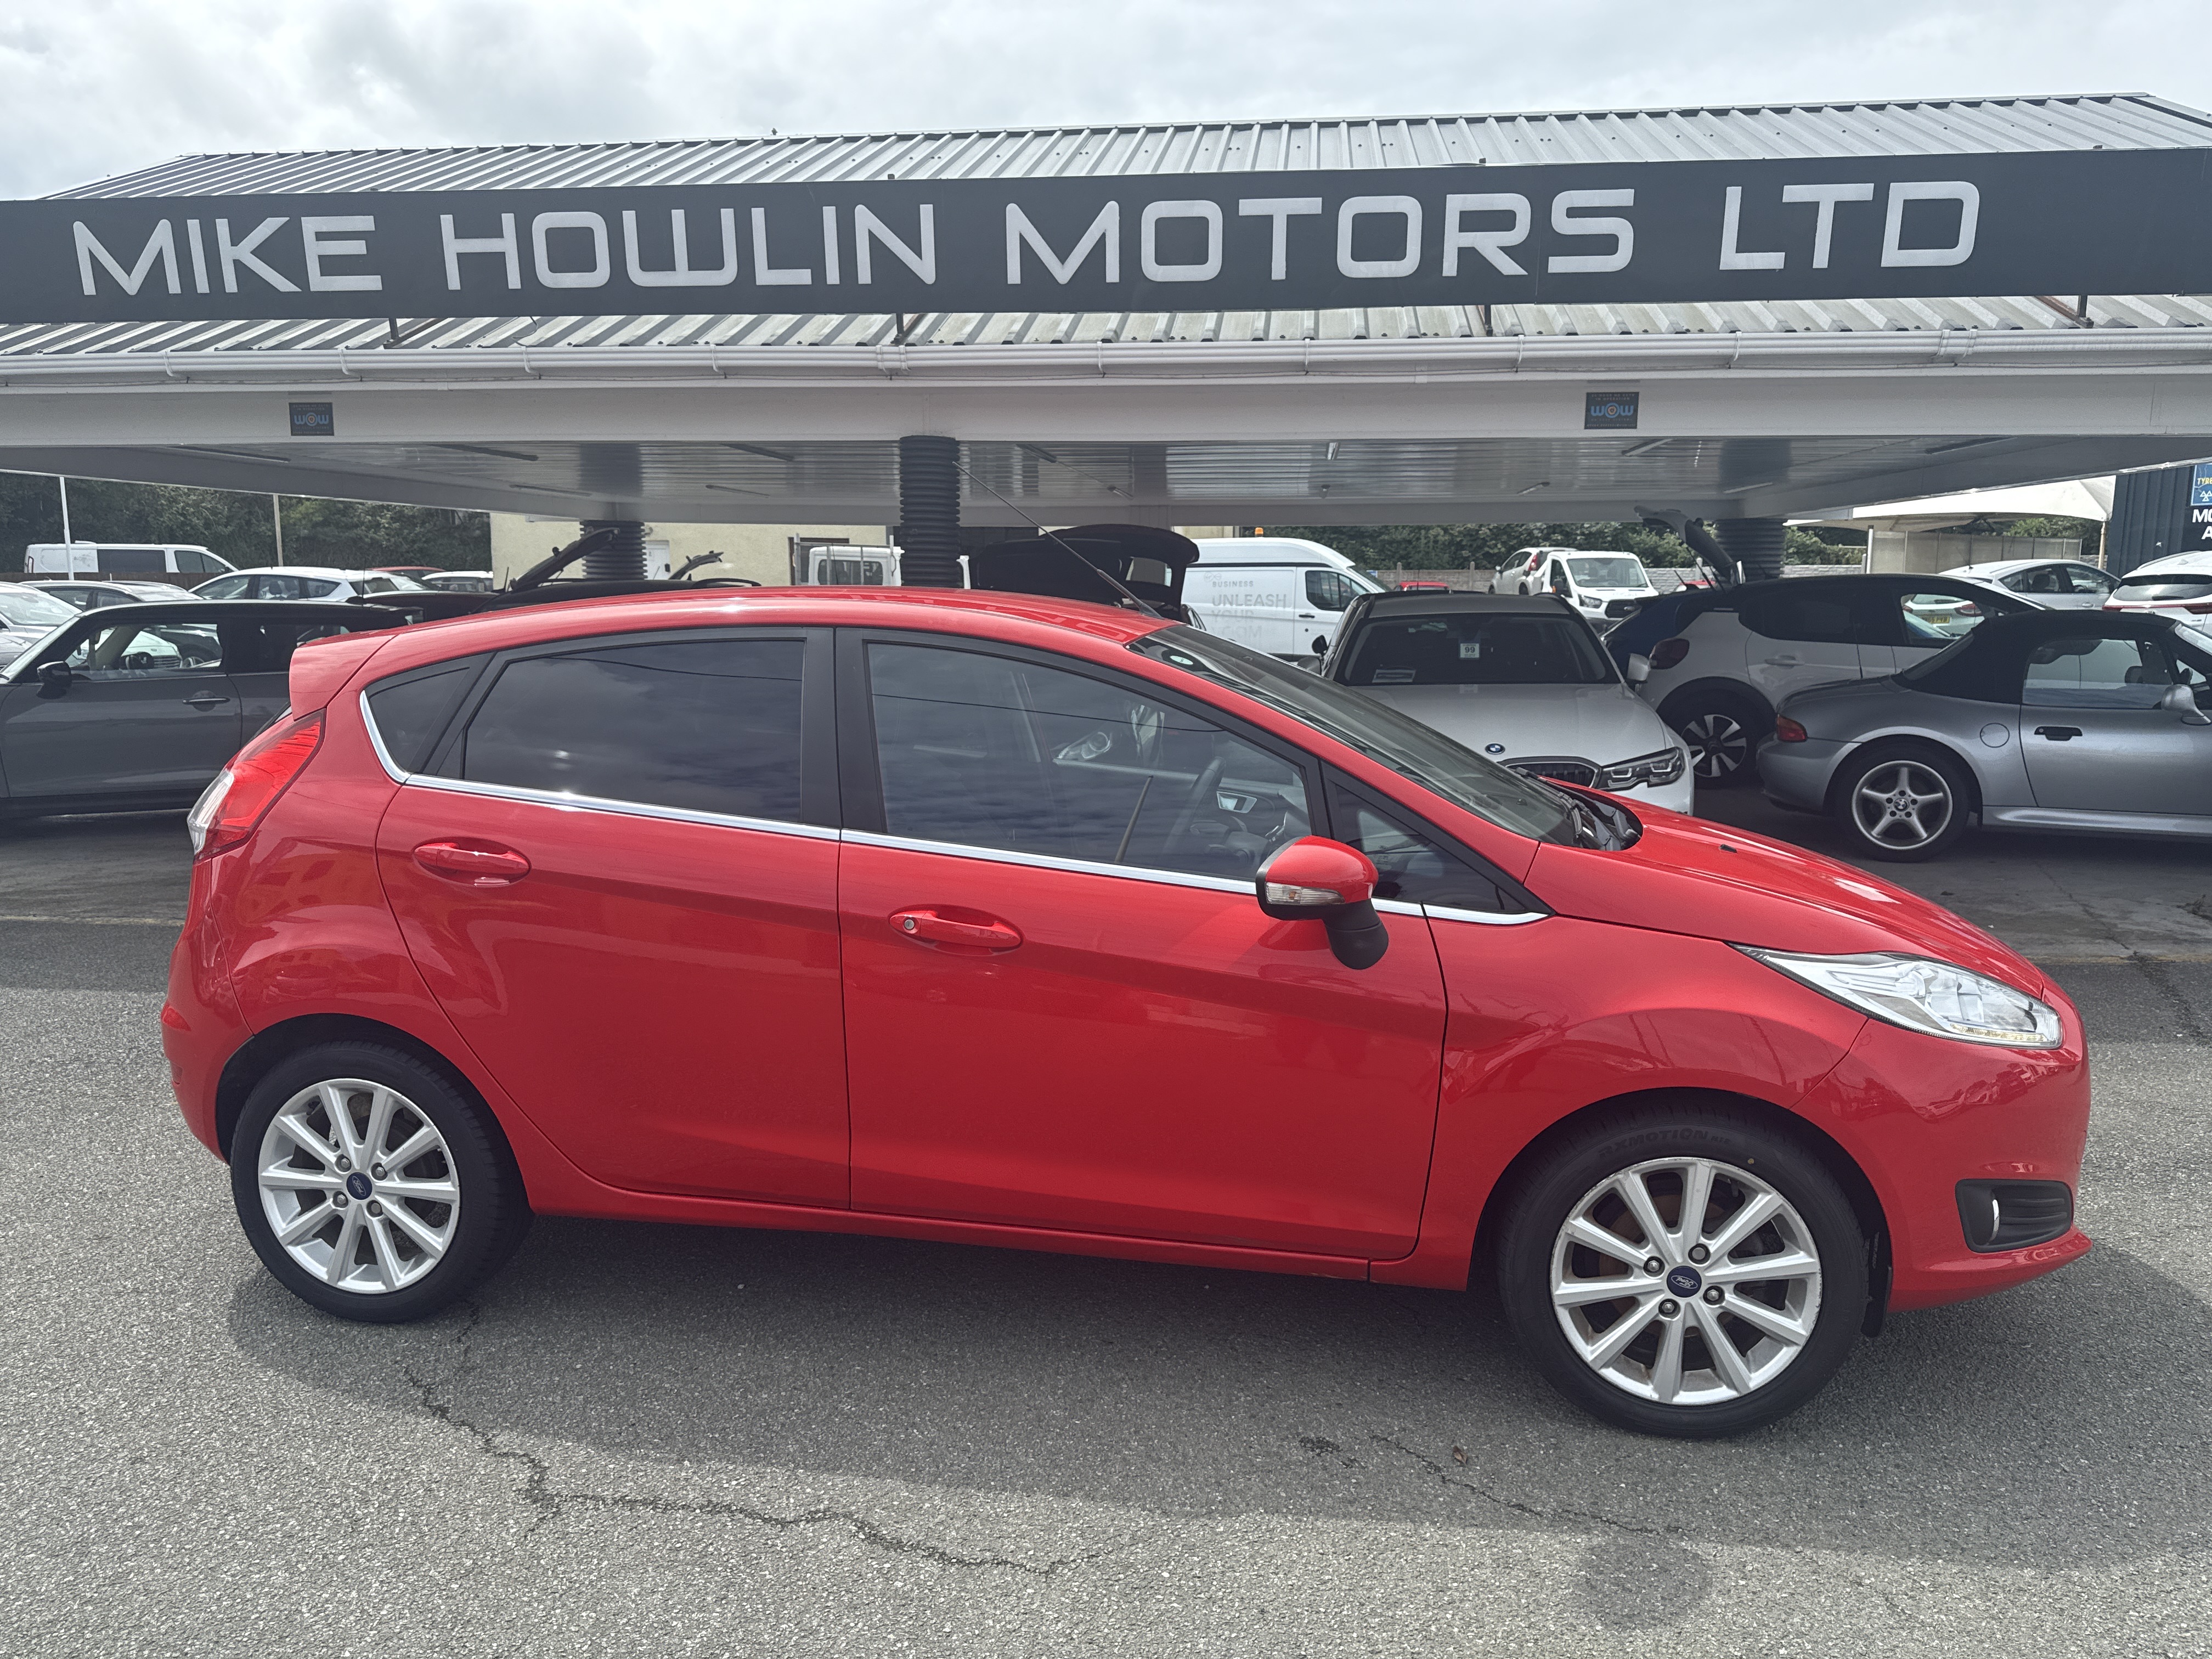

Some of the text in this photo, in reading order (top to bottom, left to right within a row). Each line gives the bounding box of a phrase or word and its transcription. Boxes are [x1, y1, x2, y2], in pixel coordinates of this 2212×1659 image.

[72, 180, 1980, 296] MIKE HOWLIN MOTORS LTD
[1212, 594, 1286, 608] UNLEASH
